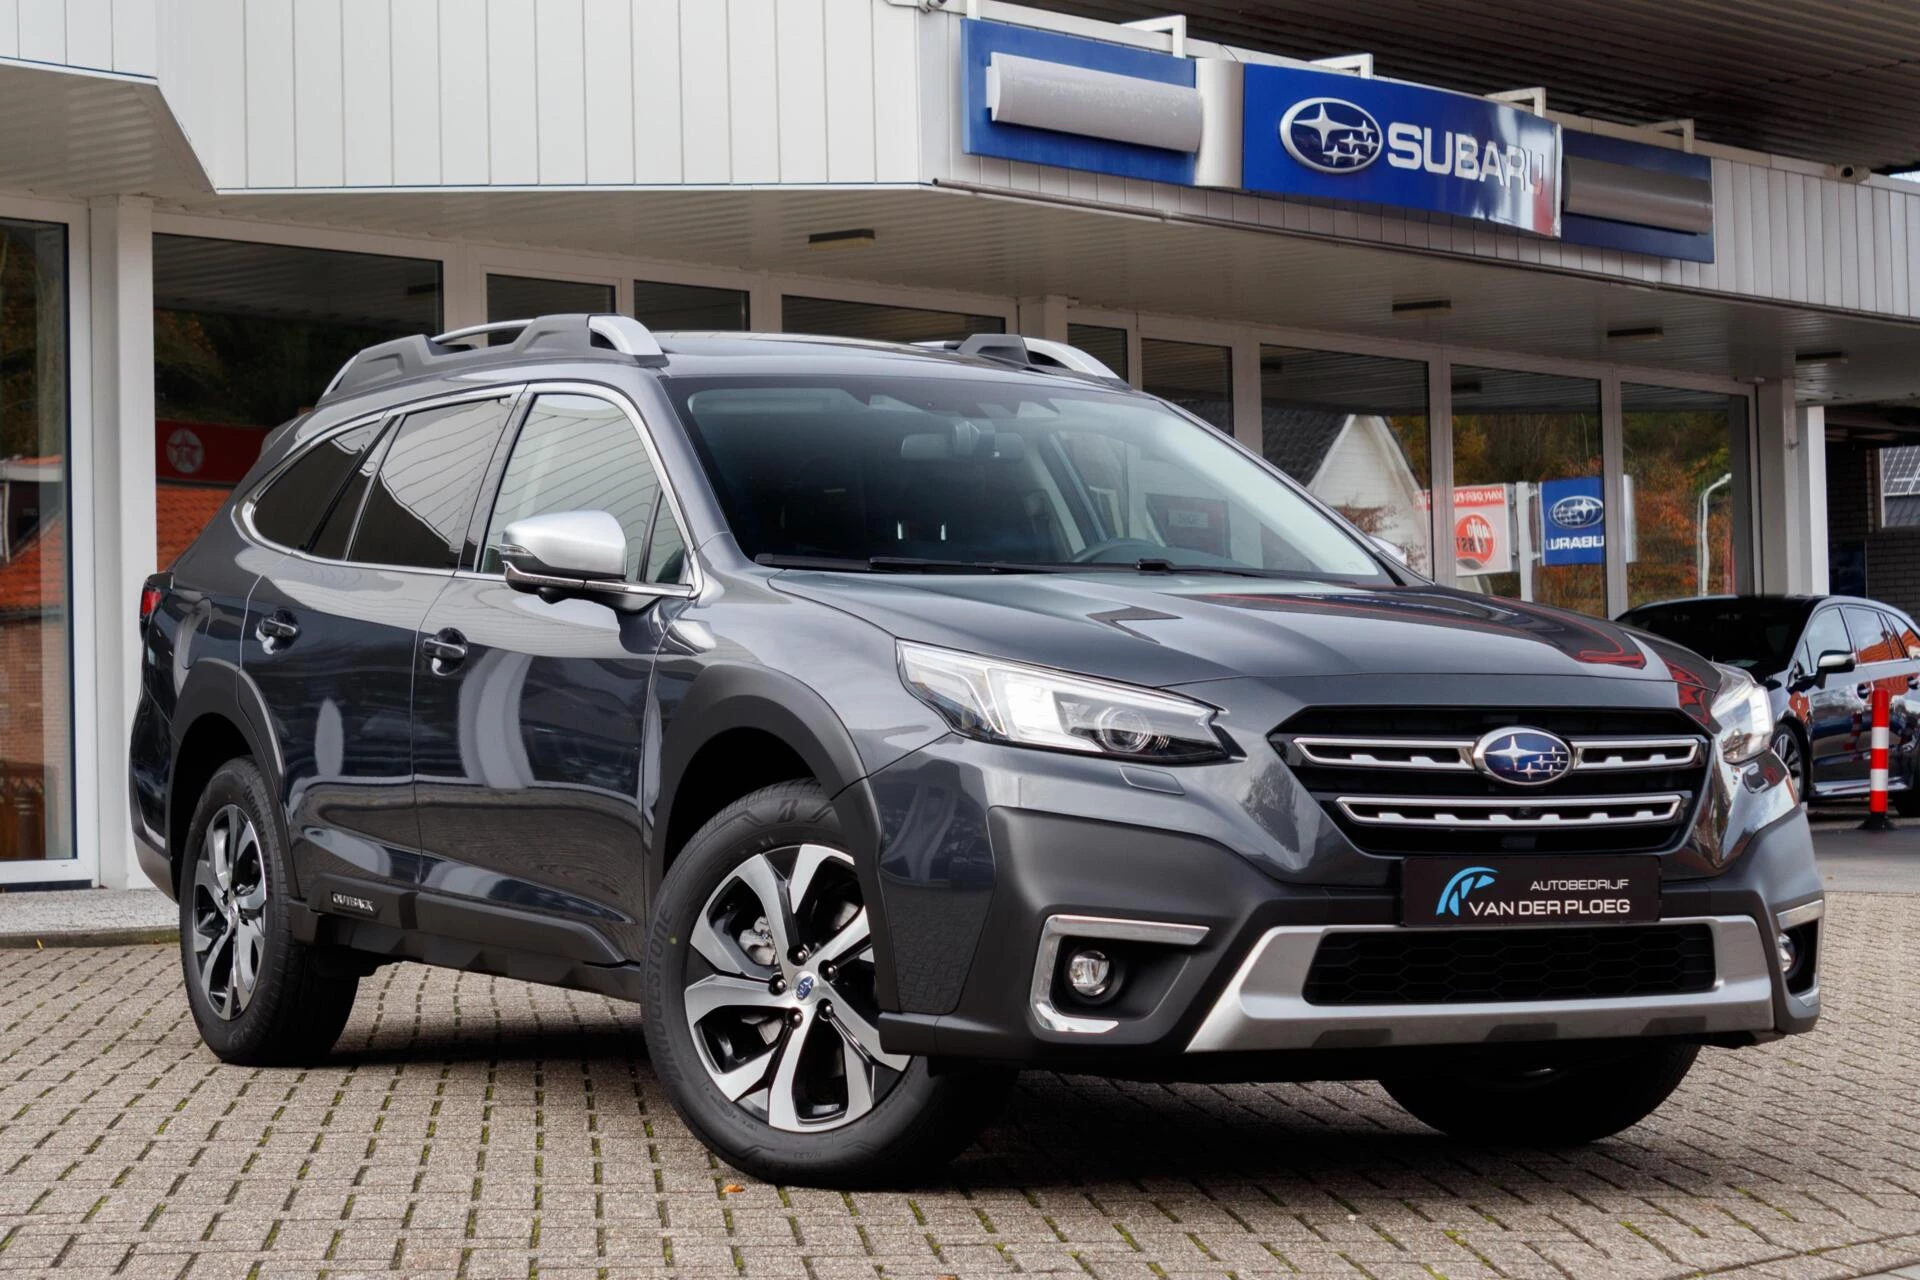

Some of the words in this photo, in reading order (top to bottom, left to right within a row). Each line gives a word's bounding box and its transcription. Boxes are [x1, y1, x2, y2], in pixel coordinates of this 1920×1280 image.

[1388, 122, 1544, 194] SUBARU
[1530, 879, 1629, 891] AUTOBEDRIJF
[332, 893, 374, 912] OUTBACK
[1468, 901, 1515, 916] VAN
[1518, 900, 1561, 915] DER
[1564, 899, 1630, 914] PLOEG
